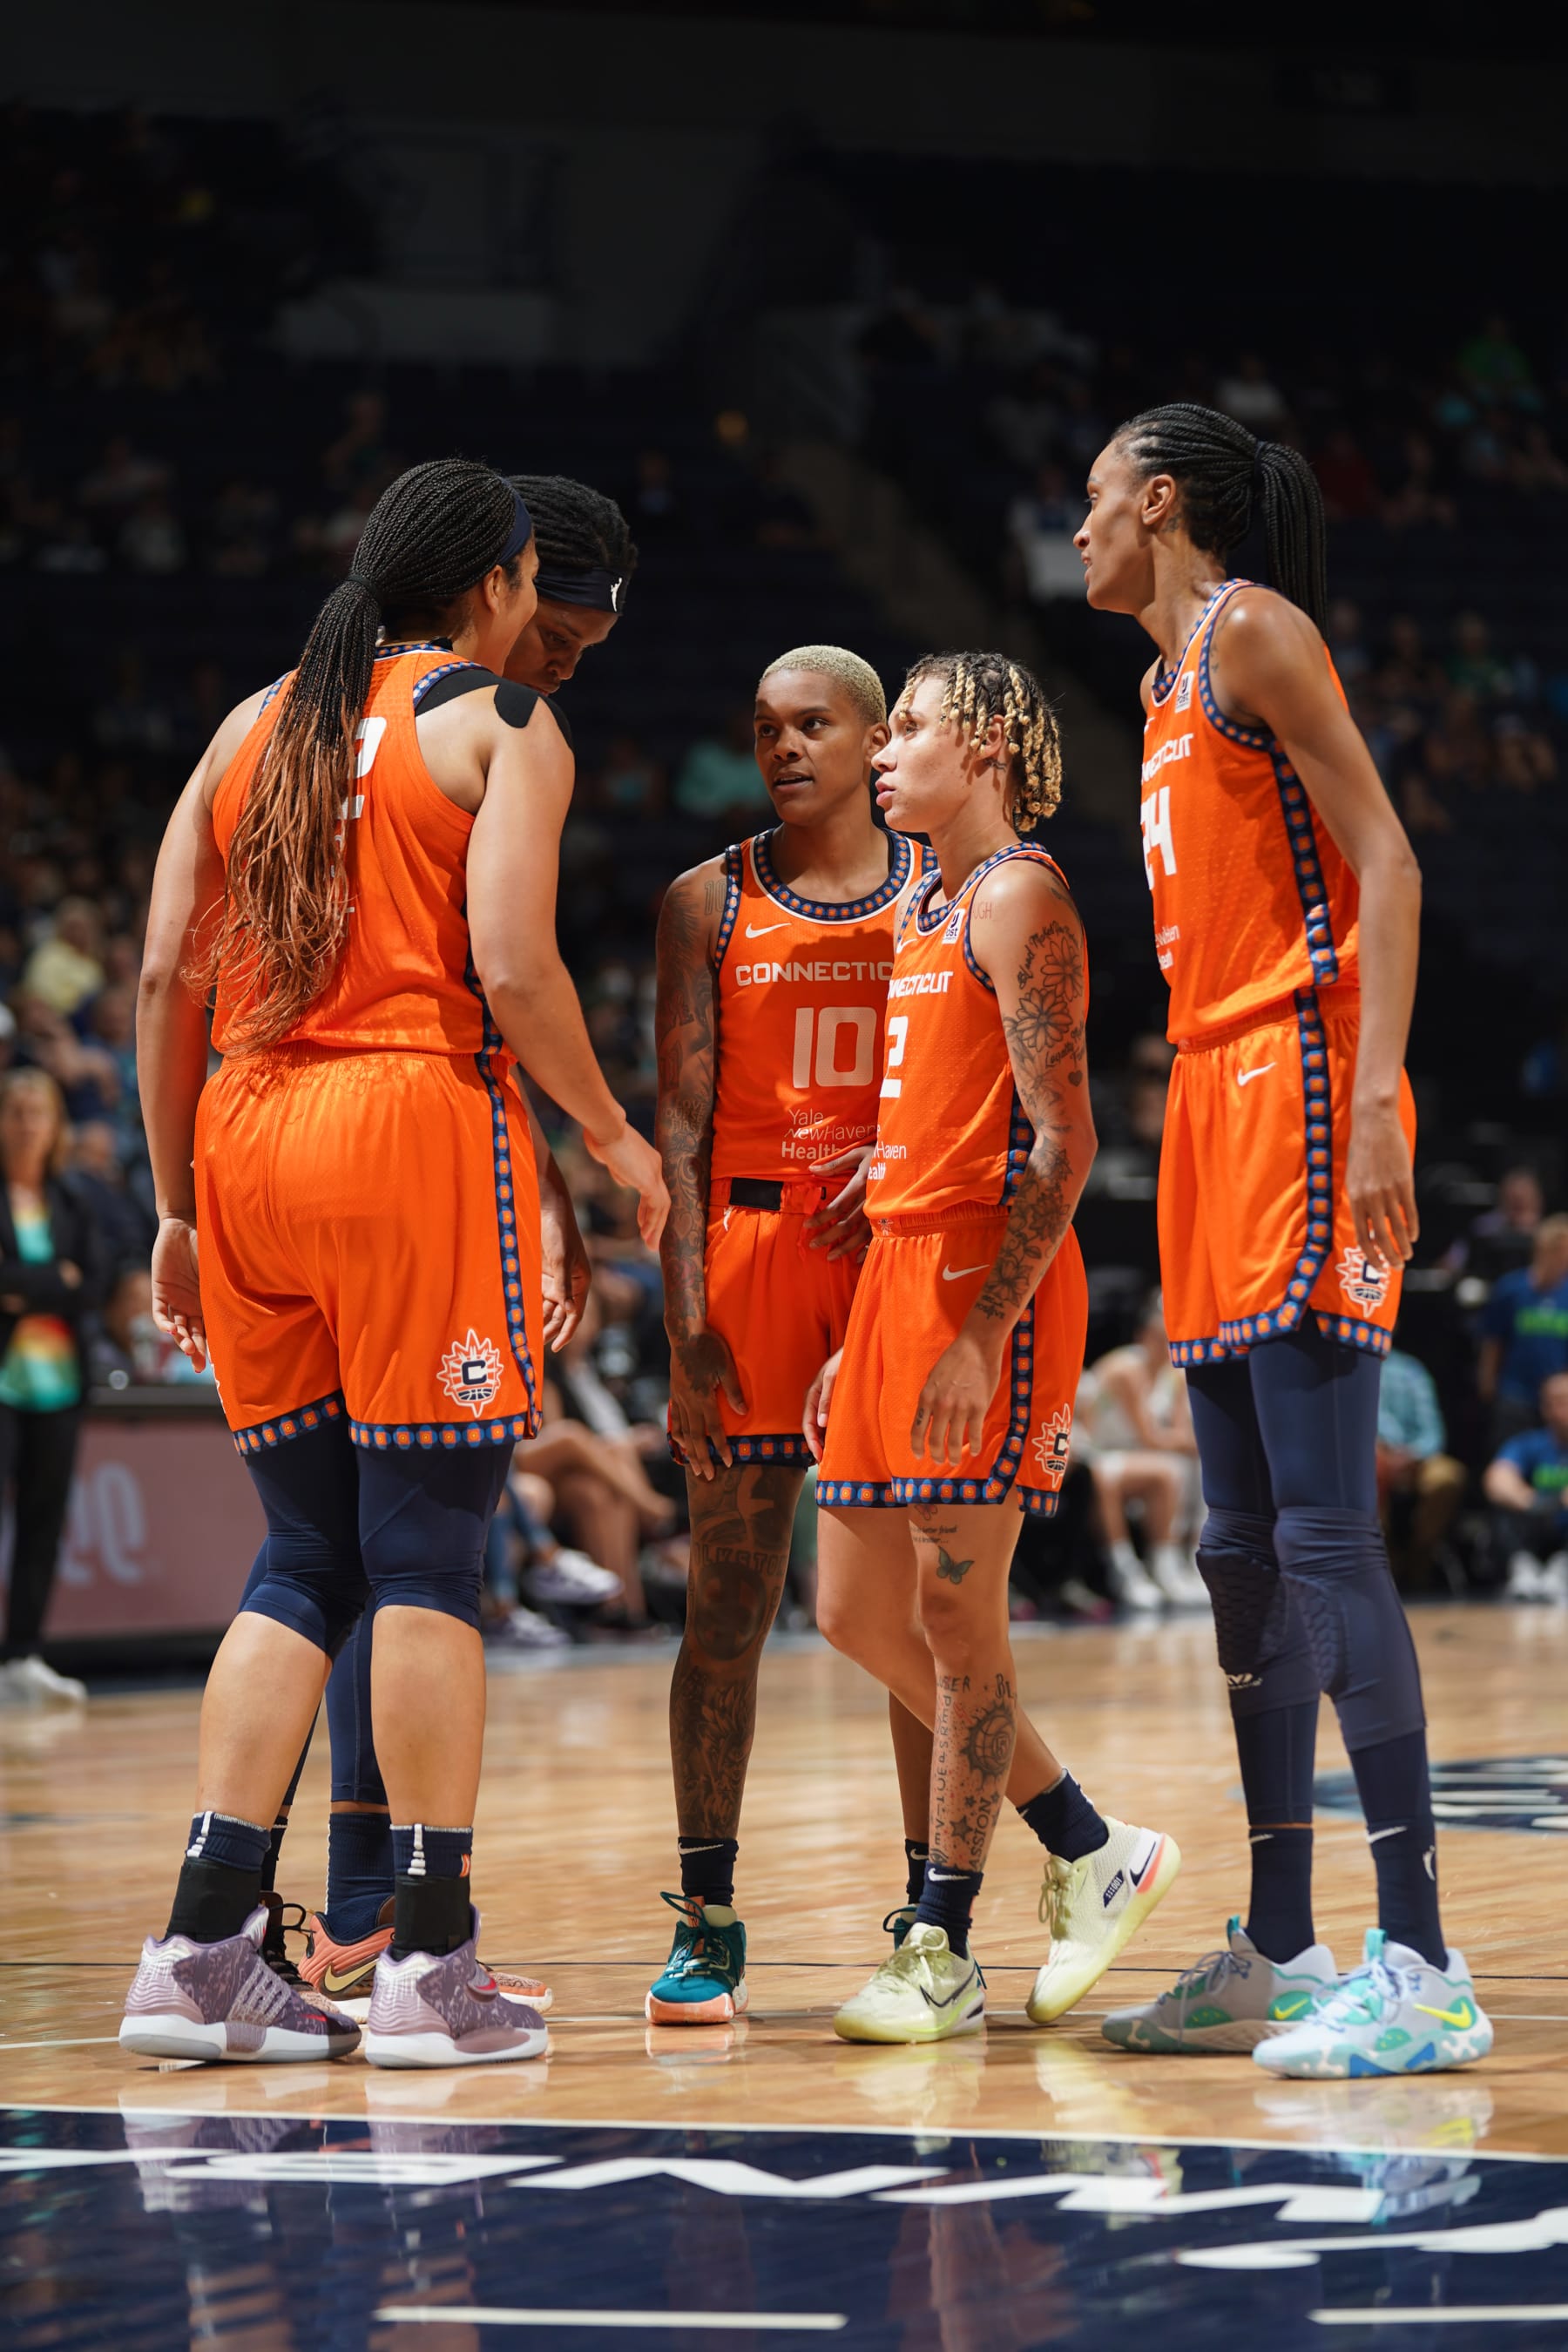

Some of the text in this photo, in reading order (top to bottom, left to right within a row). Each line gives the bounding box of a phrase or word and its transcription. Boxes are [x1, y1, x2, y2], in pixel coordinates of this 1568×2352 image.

[793, 1006, 877, 1089] 10
[788, 1107, 824, 1125] Yale
[462, 1359, 487, 1385] C
[1053, 1432, 1068, 1456] C
